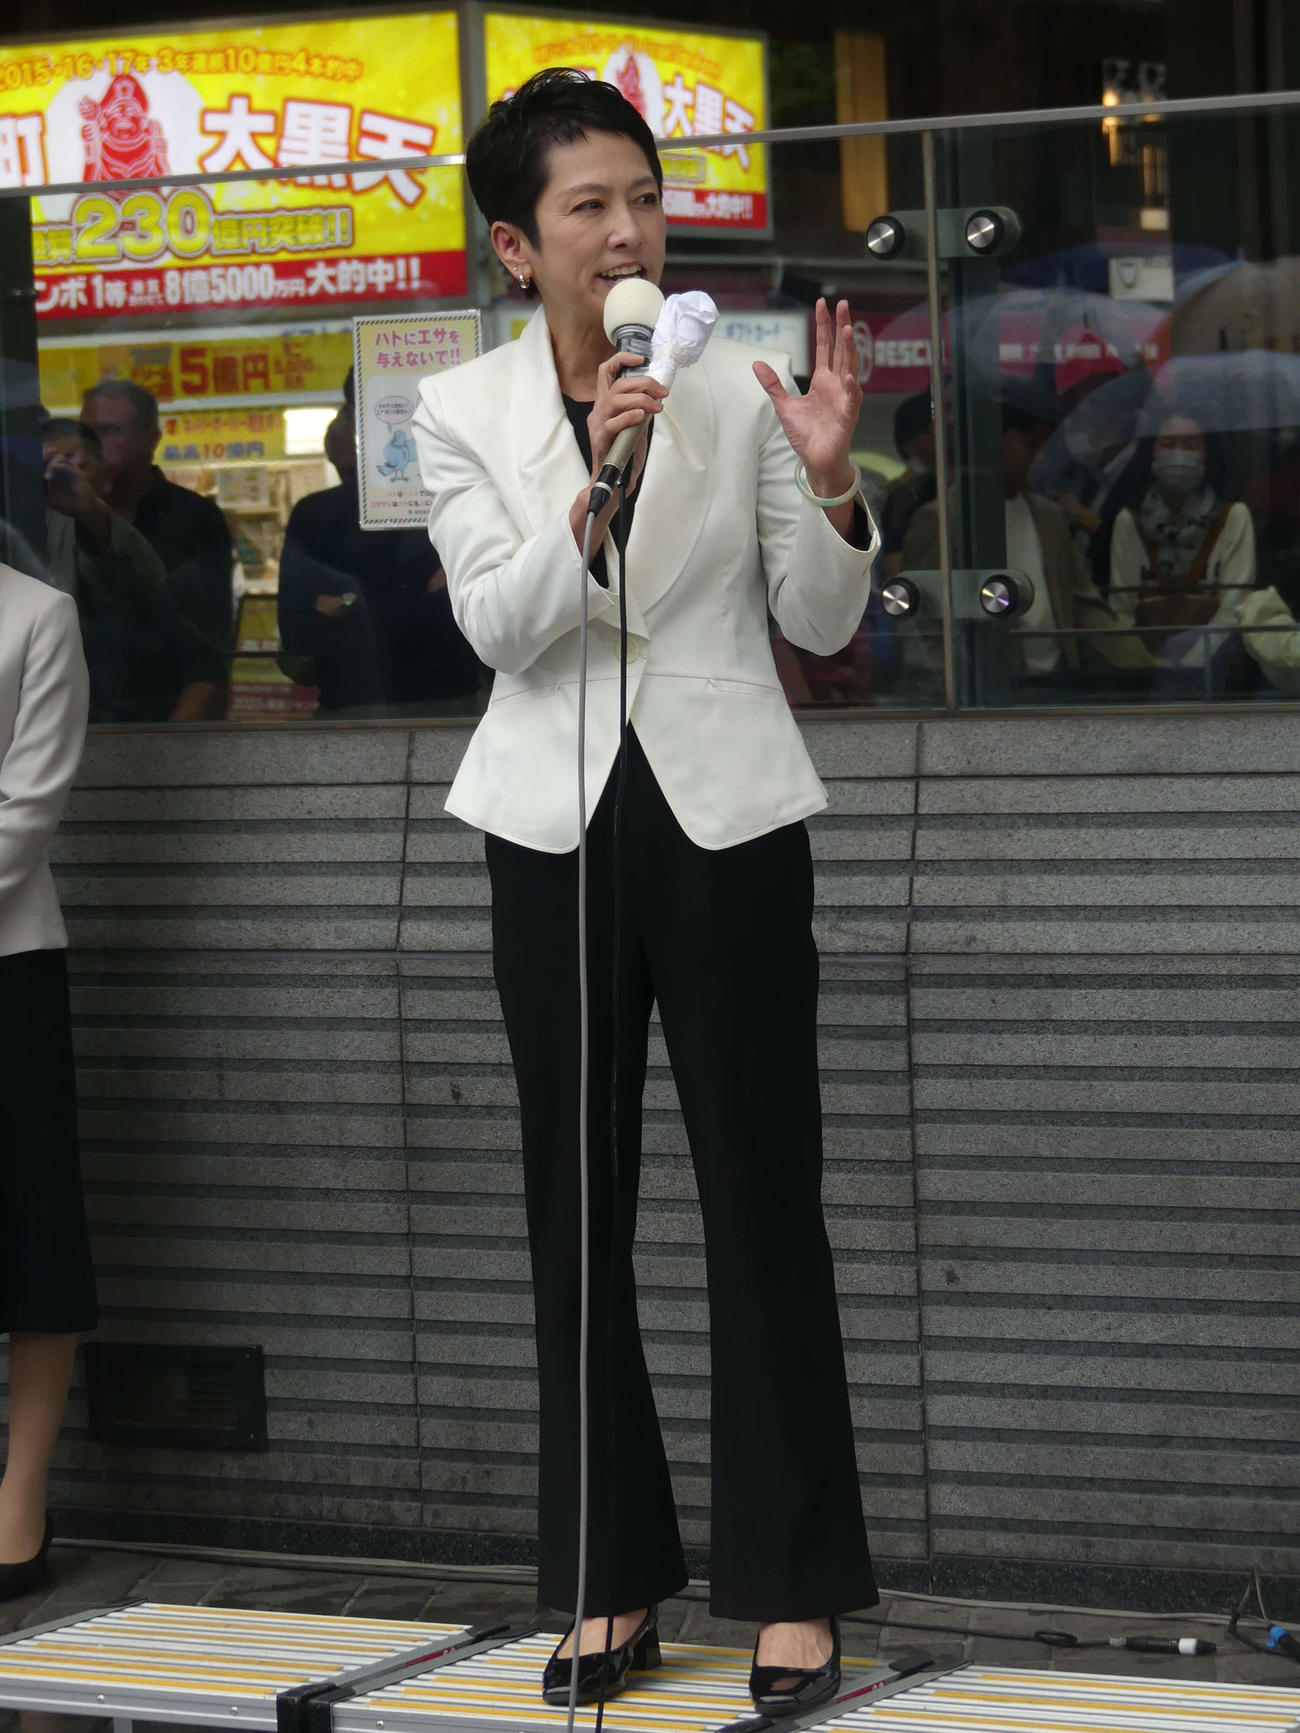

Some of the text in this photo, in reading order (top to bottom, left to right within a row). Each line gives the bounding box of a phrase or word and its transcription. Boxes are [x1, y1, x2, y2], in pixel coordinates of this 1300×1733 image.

[199, 93, 436, 207] 大黒天
[375, 327, 460, 347] ハトにエサを
[178, 346, 270, 395] 5億円
[376, 348, 461, 368] 与えないで!!
